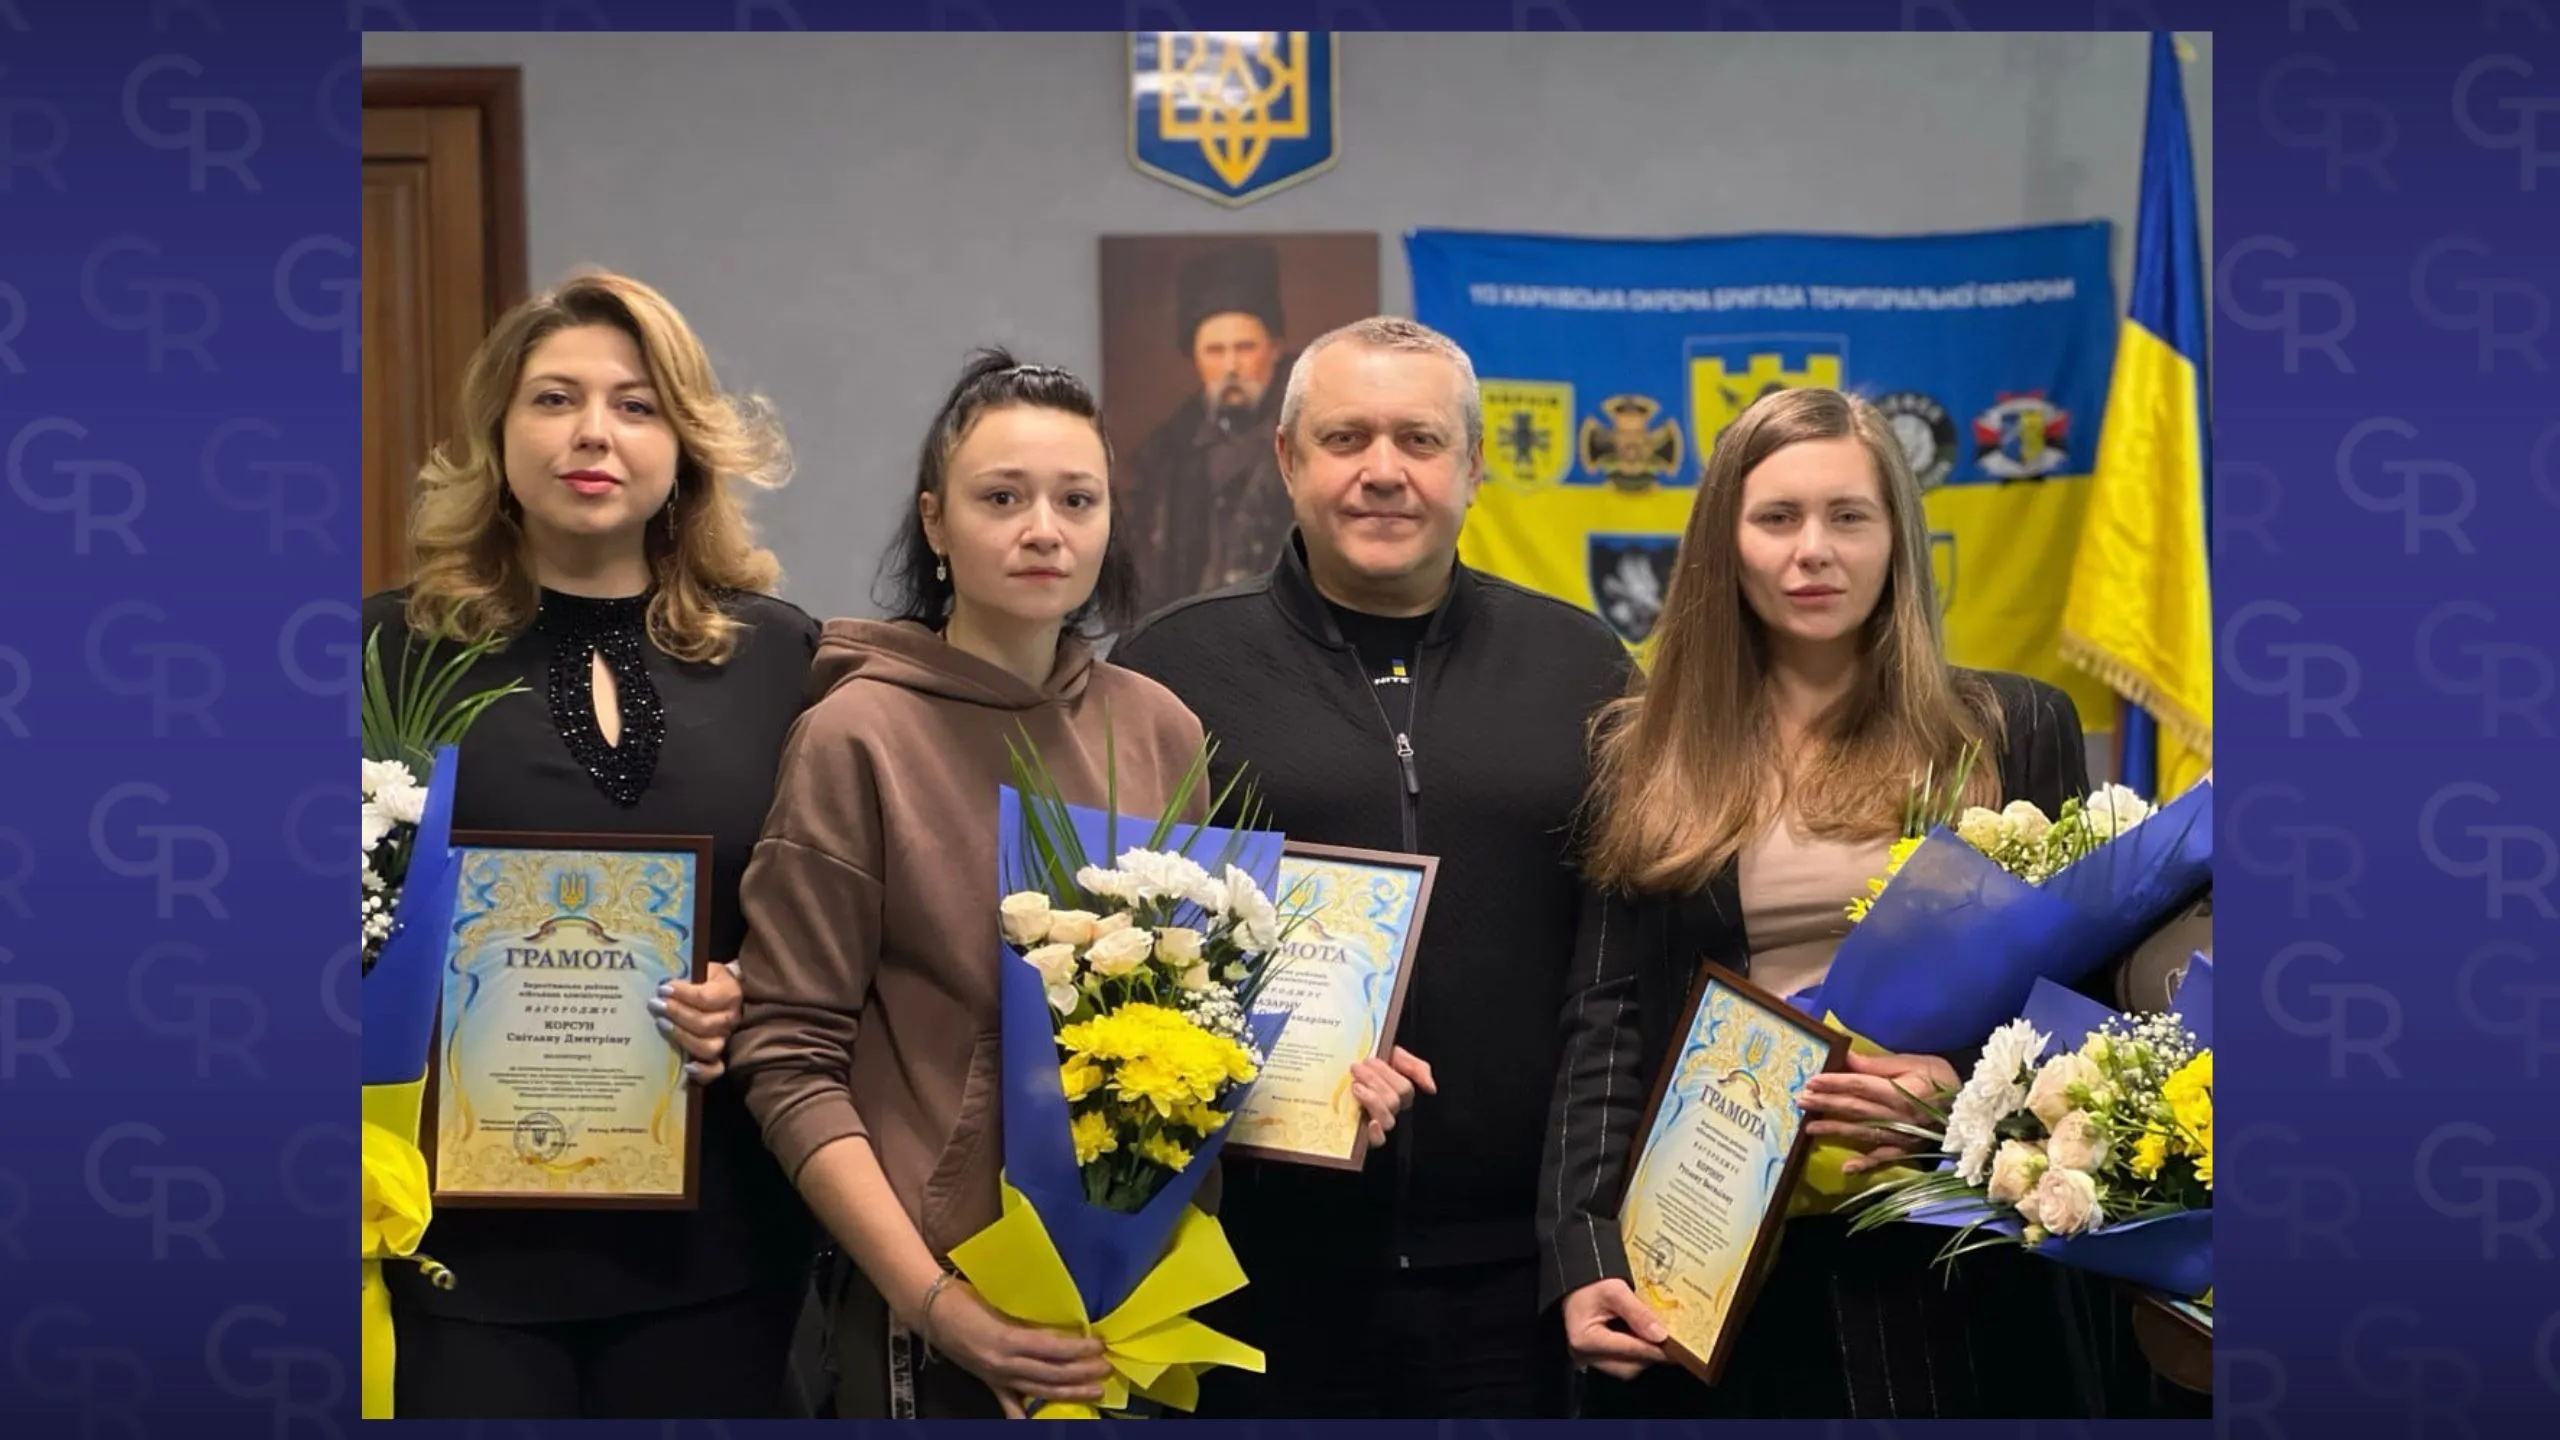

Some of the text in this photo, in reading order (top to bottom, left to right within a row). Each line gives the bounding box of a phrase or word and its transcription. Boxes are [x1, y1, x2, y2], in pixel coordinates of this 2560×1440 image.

[505, 947, 638, 970] ГРАМОТА
[1281, 941, 1347, 964] МОТА
[544, 1020, 595, 1031] КОРСУН
[506, 1032, 560, 1044] Світлану
[1700, 1084, 1767, 1142] ГРАМОТА
